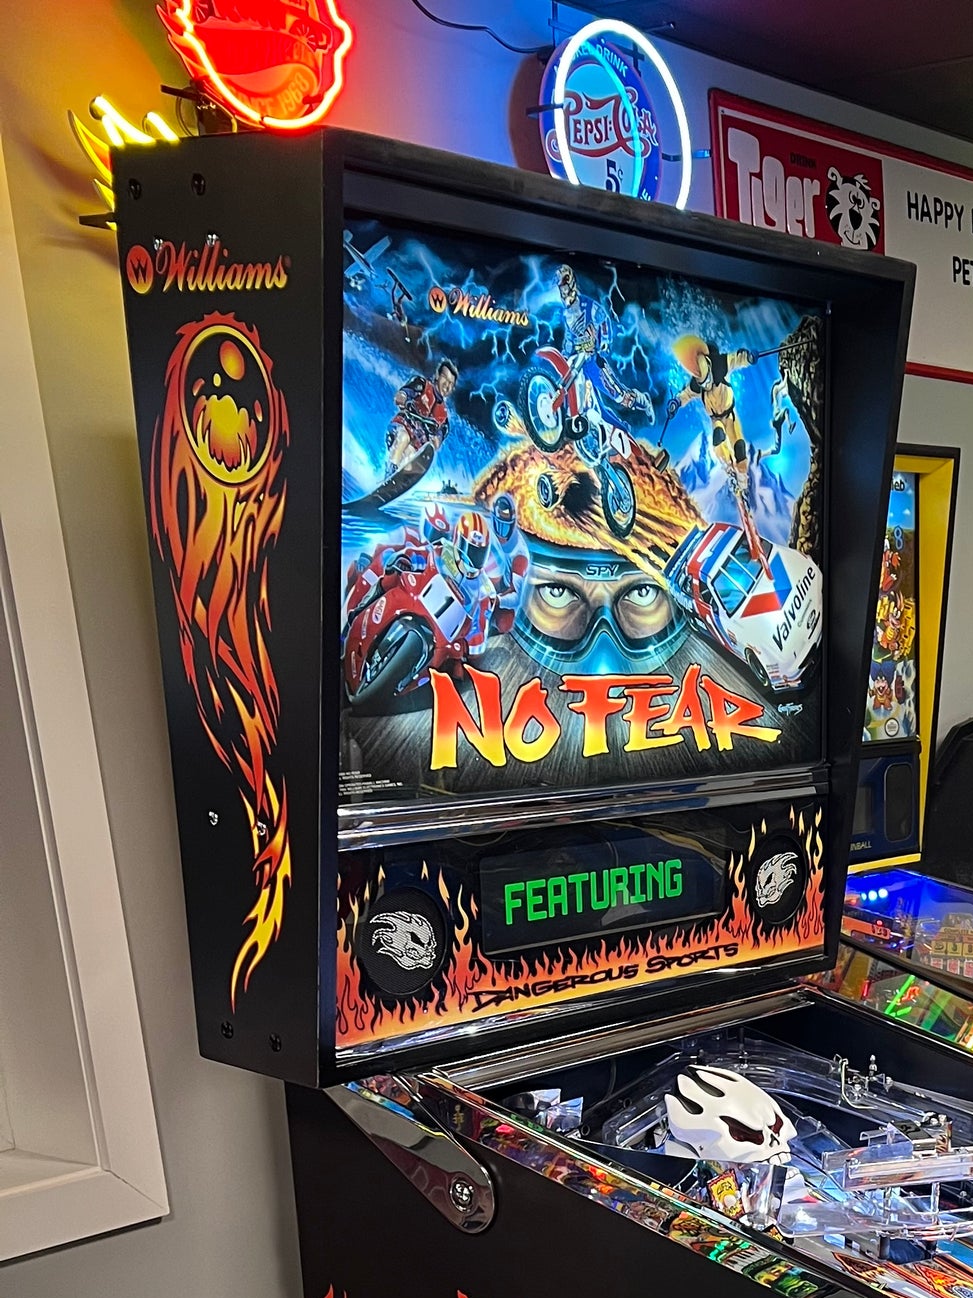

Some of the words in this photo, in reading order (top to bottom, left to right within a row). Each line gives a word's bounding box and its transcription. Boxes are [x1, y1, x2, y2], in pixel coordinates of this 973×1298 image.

[728, 127, 820, 238] Tiger
[907, 191, 964, 231] HAPPY
[156, 241, 288, 292] Williams
[449, 287, 529, 326] Williams
[585, 563, 620, 577] SPY
[773, 565, 816, 651] Valvoline
[428, 664, 562, 770] NO
[554, 663, 782, 757] FEAR
[850, 840, 872, 851] INBALL
[503, 858, 684, 925] FEATURING
[466, 964, 639, 1013] DANGEROUS
[644, 943, 739, 973] SPORTS
